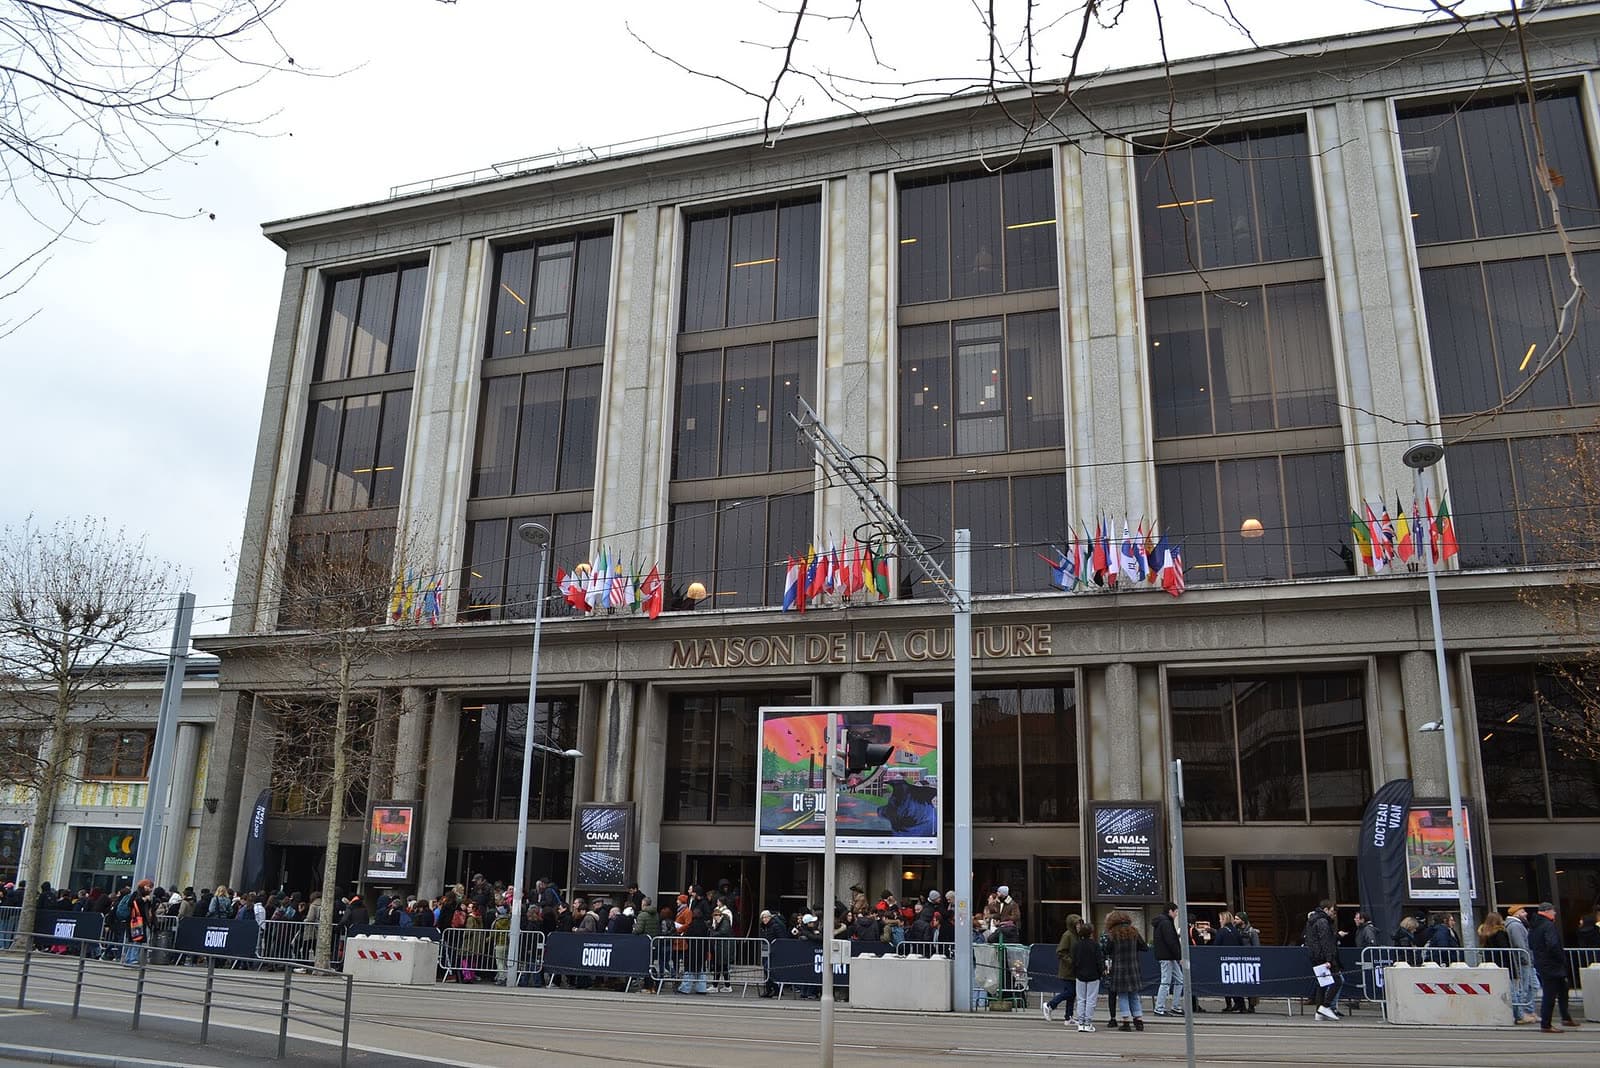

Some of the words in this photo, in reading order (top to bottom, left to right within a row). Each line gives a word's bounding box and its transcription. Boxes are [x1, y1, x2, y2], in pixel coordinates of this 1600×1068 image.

[669, 635, 795, 669] MAISON
[804, 632, 847, 665] DE
[856, 631, 897, 662] LA
[903, 623, 1052, 661] CUTURE
[1374, 803, 1389, 847] COCTEAU
[1389, 805, 1402, 829] VIAN
[586, 832, 620, 840] CANAL+
[1104, 835, 1148, 844] CANAL+
[205, 930, 229, 948] COURT
[581, 948, 613, 967] COURT
[1221, 962, 1261, 984] COURT
